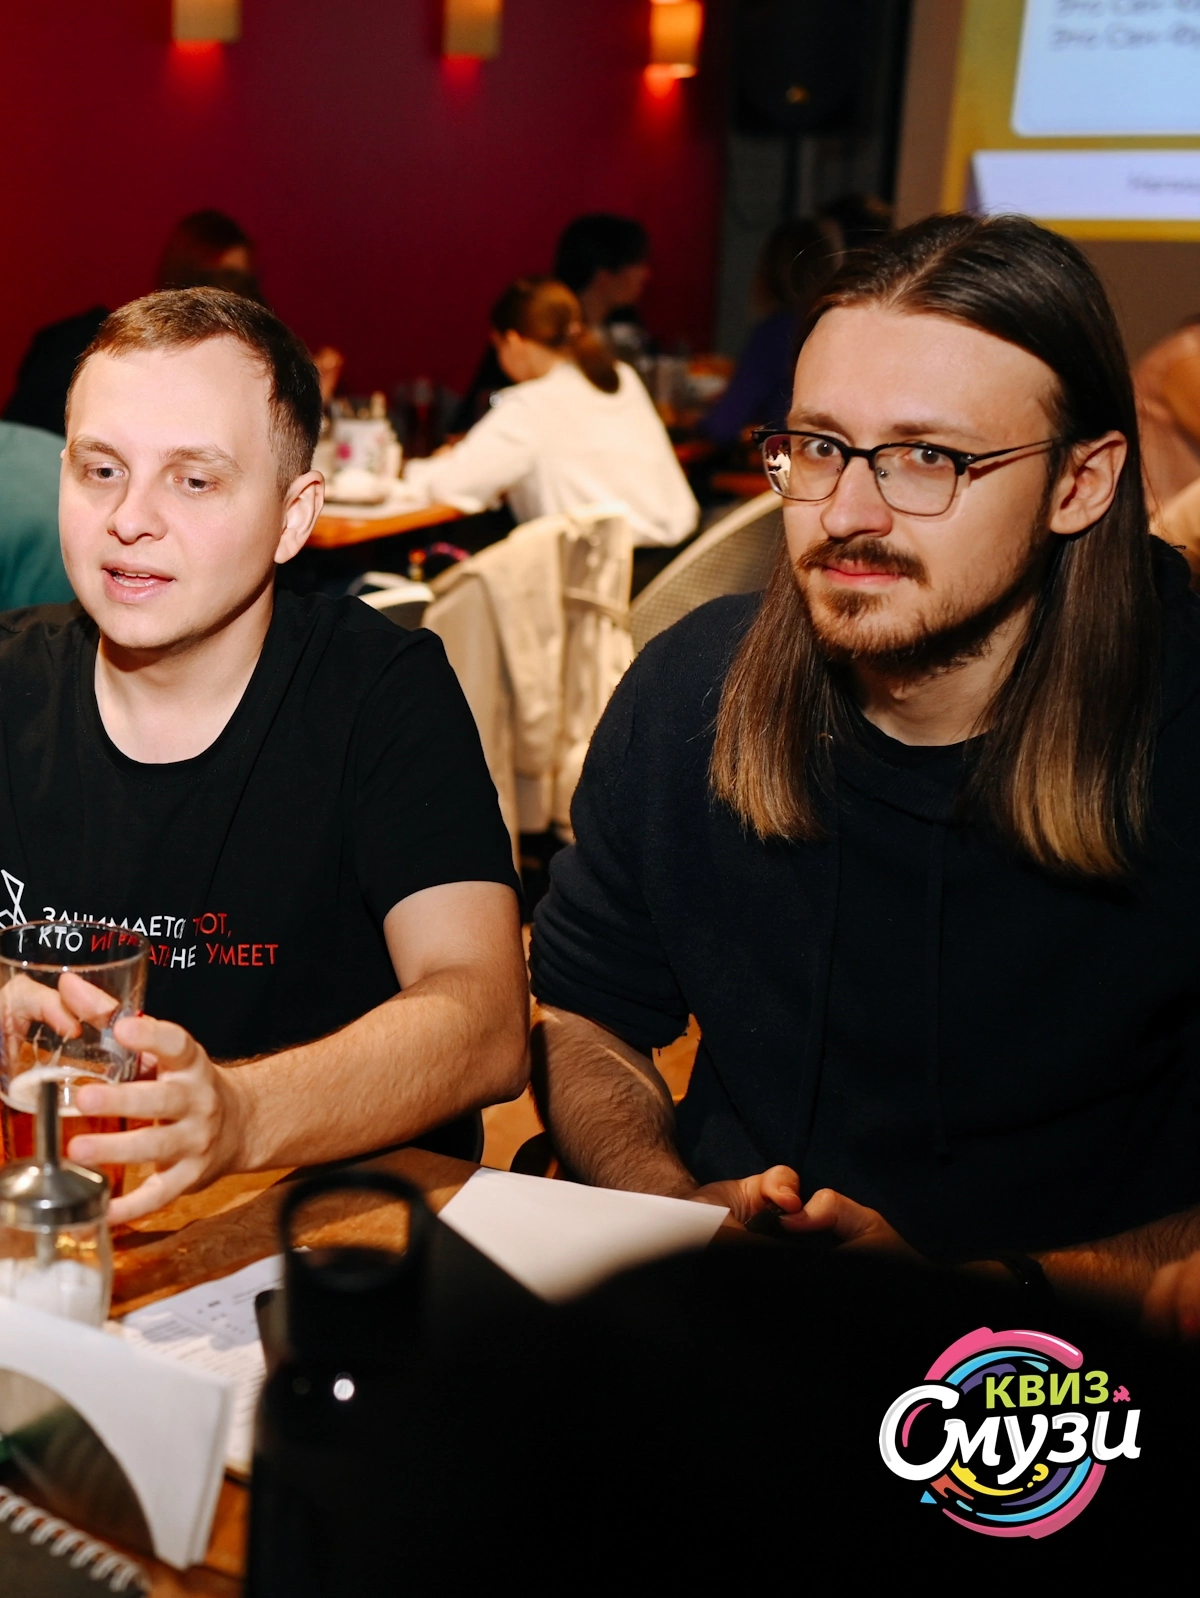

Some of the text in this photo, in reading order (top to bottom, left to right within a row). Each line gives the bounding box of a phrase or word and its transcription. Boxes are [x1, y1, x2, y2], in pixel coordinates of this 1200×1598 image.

[38, 926, 84, 953] КТО
[170, 944, 197, 969] НЕ
[205, 942, 279, 967] УМЕЕТ
